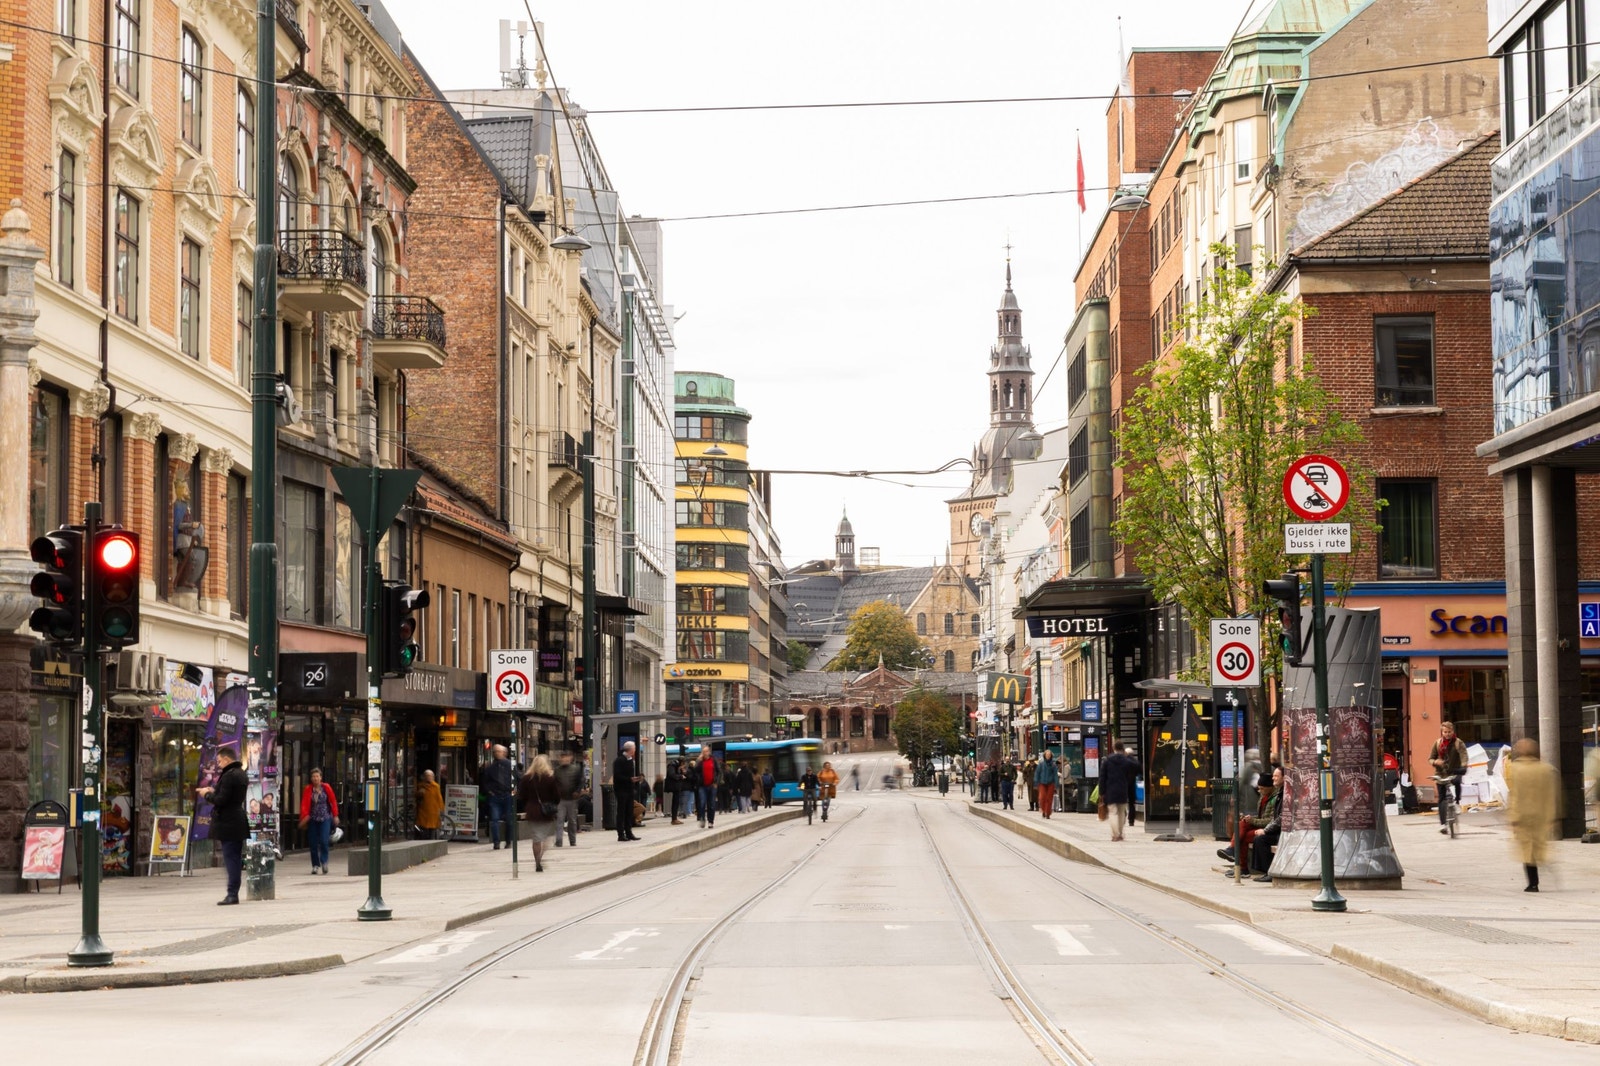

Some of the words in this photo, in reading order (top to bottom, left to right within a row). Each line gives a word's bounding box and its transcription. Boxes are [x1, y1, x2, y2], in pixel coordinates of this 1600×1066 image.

[1288, 527, 1323, 538] Gjelder
[1327, 526, 1348, 536] ikke
[1290, 539, 1314, 548] buss
[1318, 539, 1321, 547] i
[1325, 539, 1346, 548] rute
[1043, 618, 1109, 634] HOTEL
[1219, 623, 1251, 635] Sone
[498, 653, 527, 664] Sone
[1224, 652, 1248, 671] 30
[305, 666, 324, 687] 26
[686, 667, 721, 677] azerion
[405, 672, 436, 692] STORGATA
[438, 676, 446, 694] 26
[502, 679, 524, 696] 30
